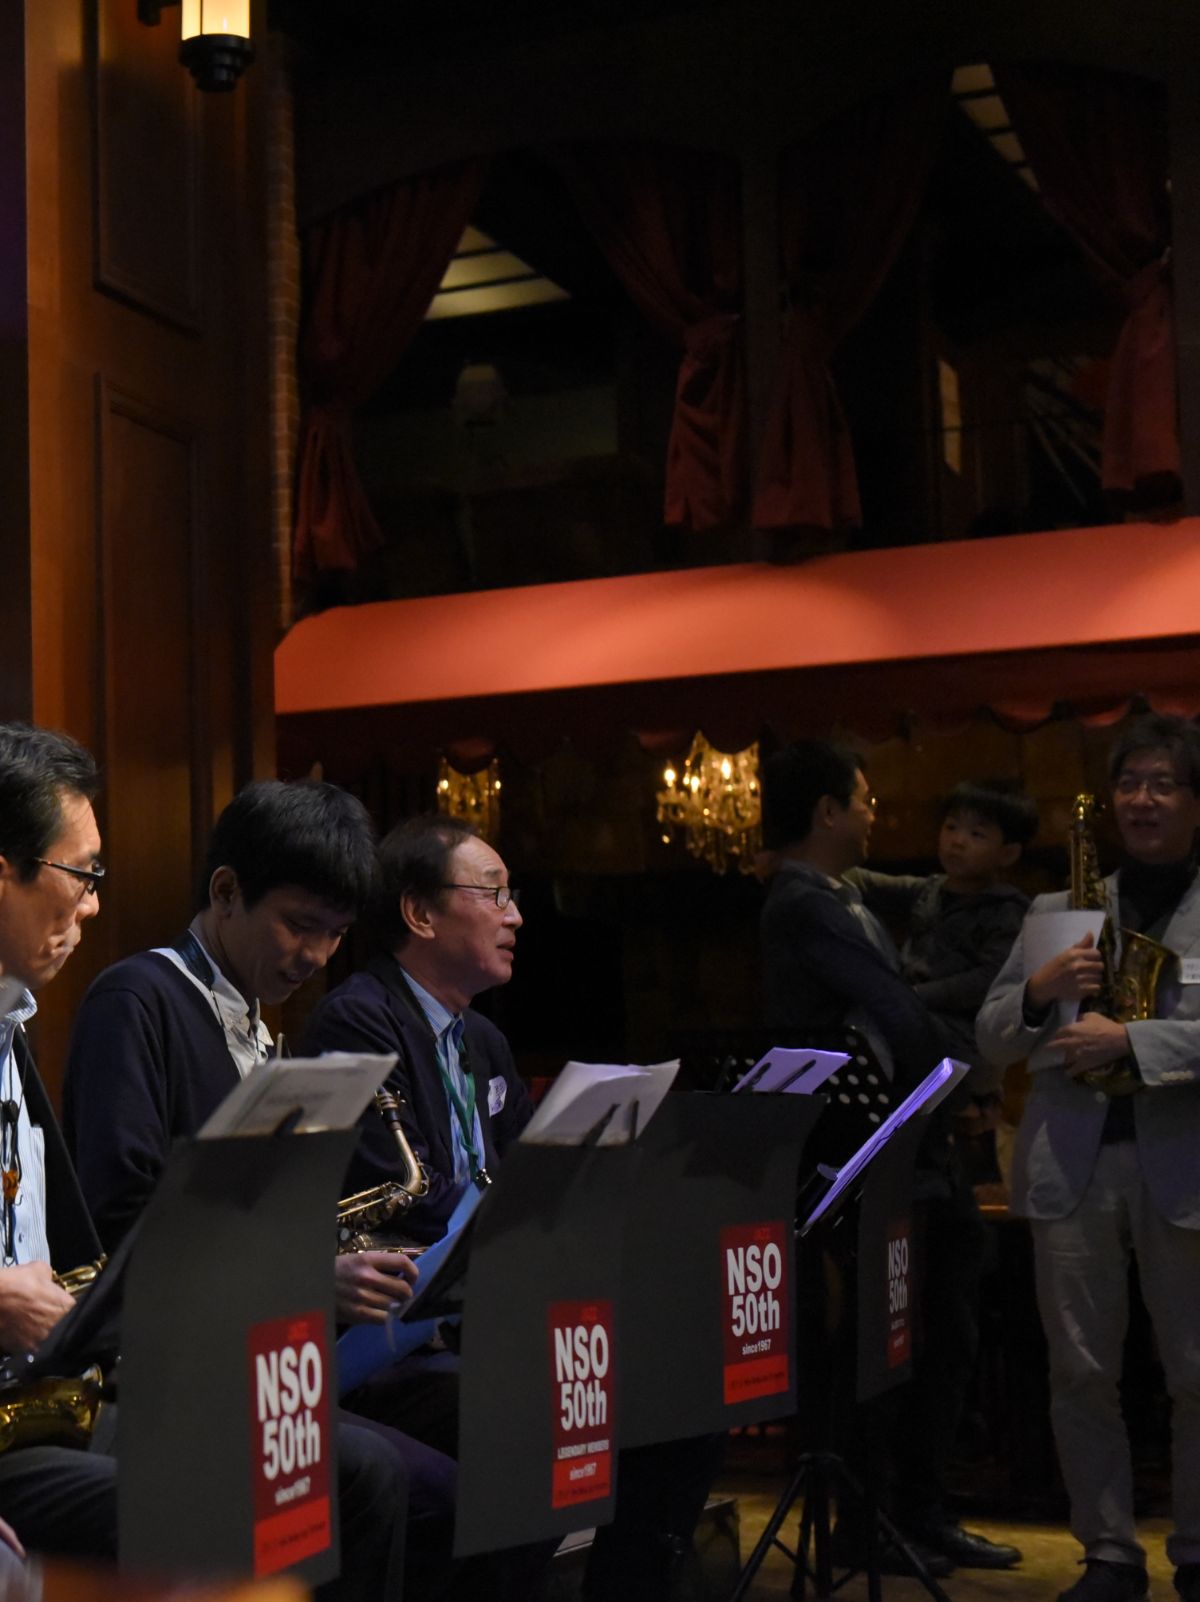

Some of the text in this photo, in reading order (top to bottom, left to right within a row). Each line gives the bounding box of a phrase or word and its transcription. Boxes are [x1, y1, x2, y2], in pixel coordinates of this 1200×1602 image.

[726, 1243, 782, 1296] NSO
[888, 1237, 909, 1280] NSO
[731, 1291, 780, 1337] 50th
[554, 1324, 609, 1383] NSO
[255, 1341, 323, 1423] NSO
[560, 1379, 607, 1431] 50th
[262, 1408, 321, 1480] 50th
